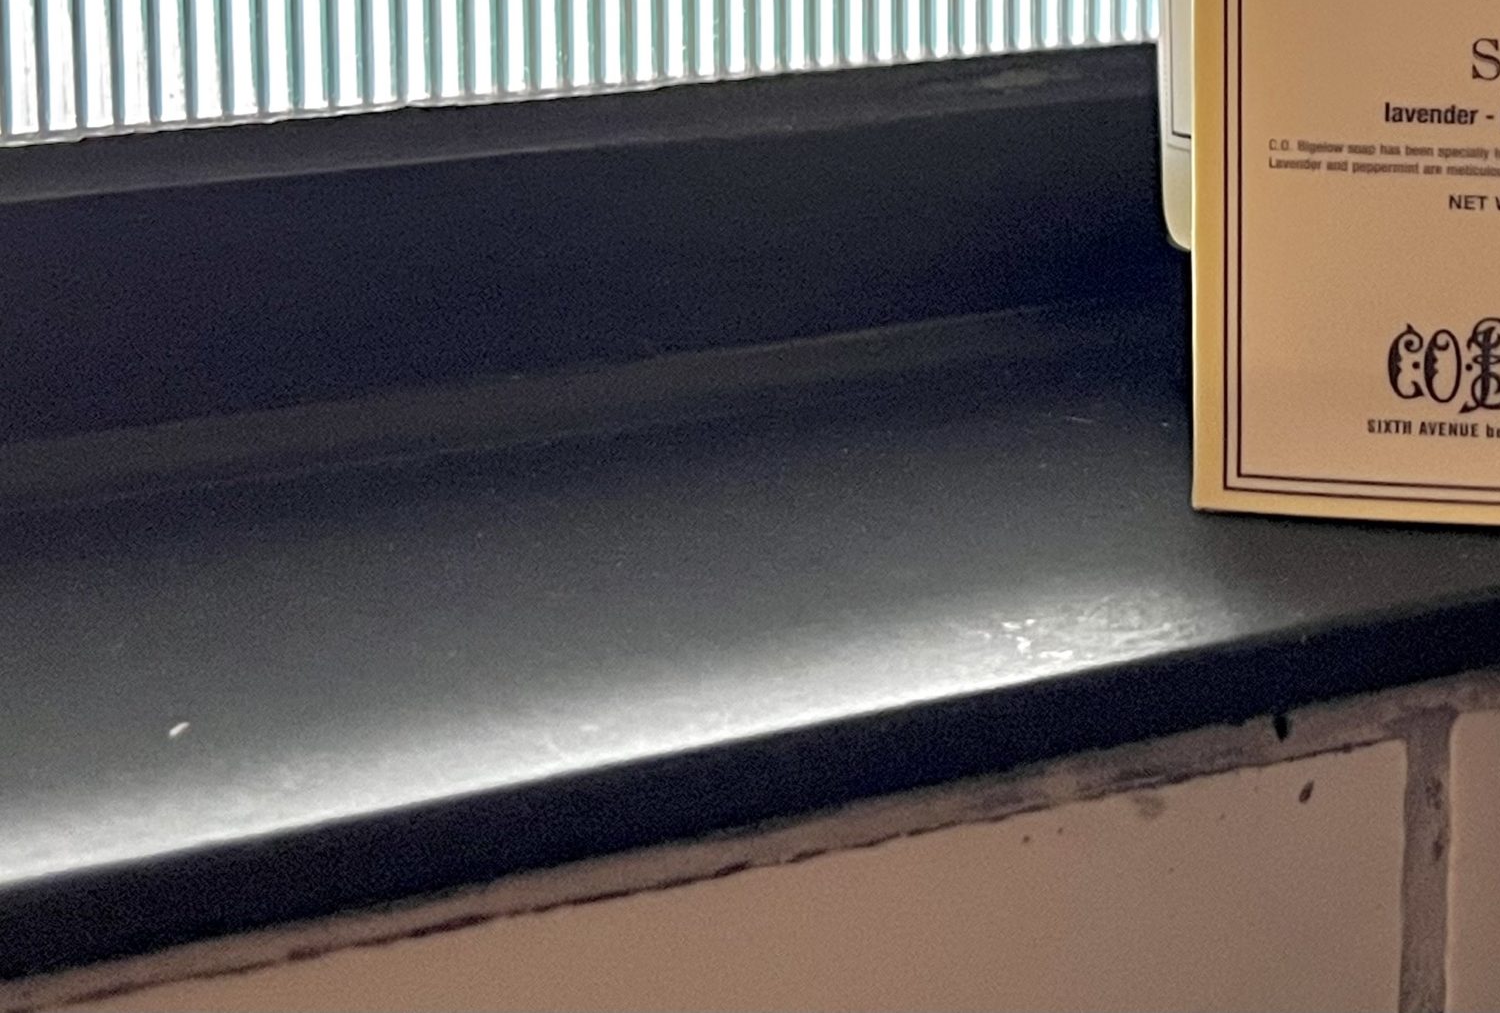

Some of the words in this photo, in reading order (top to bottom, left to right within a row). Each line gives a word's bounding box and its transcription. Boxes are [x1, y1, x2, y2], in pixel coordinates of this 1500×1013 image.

[1384, 101, 1479, 126] lavender
[1298, 140, 1343, 155] Bigelow
[1348, 144, 1376, 157] soap
[1380, 144, 1401, 156] has
[1405, 144, 1434, 156] been
[1438, 146, 1489, 159] specially
[1269, 157, 1322, 170] Lavender
[1327, 160, 1348, 172] and
[1352, 161, 1419, 175] peppermint
[1423, 163, 1442, 175] are
[1448, 194, 1489, 211] NET
[1367, 418, 1412, 436] SIXTH
[1419, 420, 1479, 438] AVENUE
